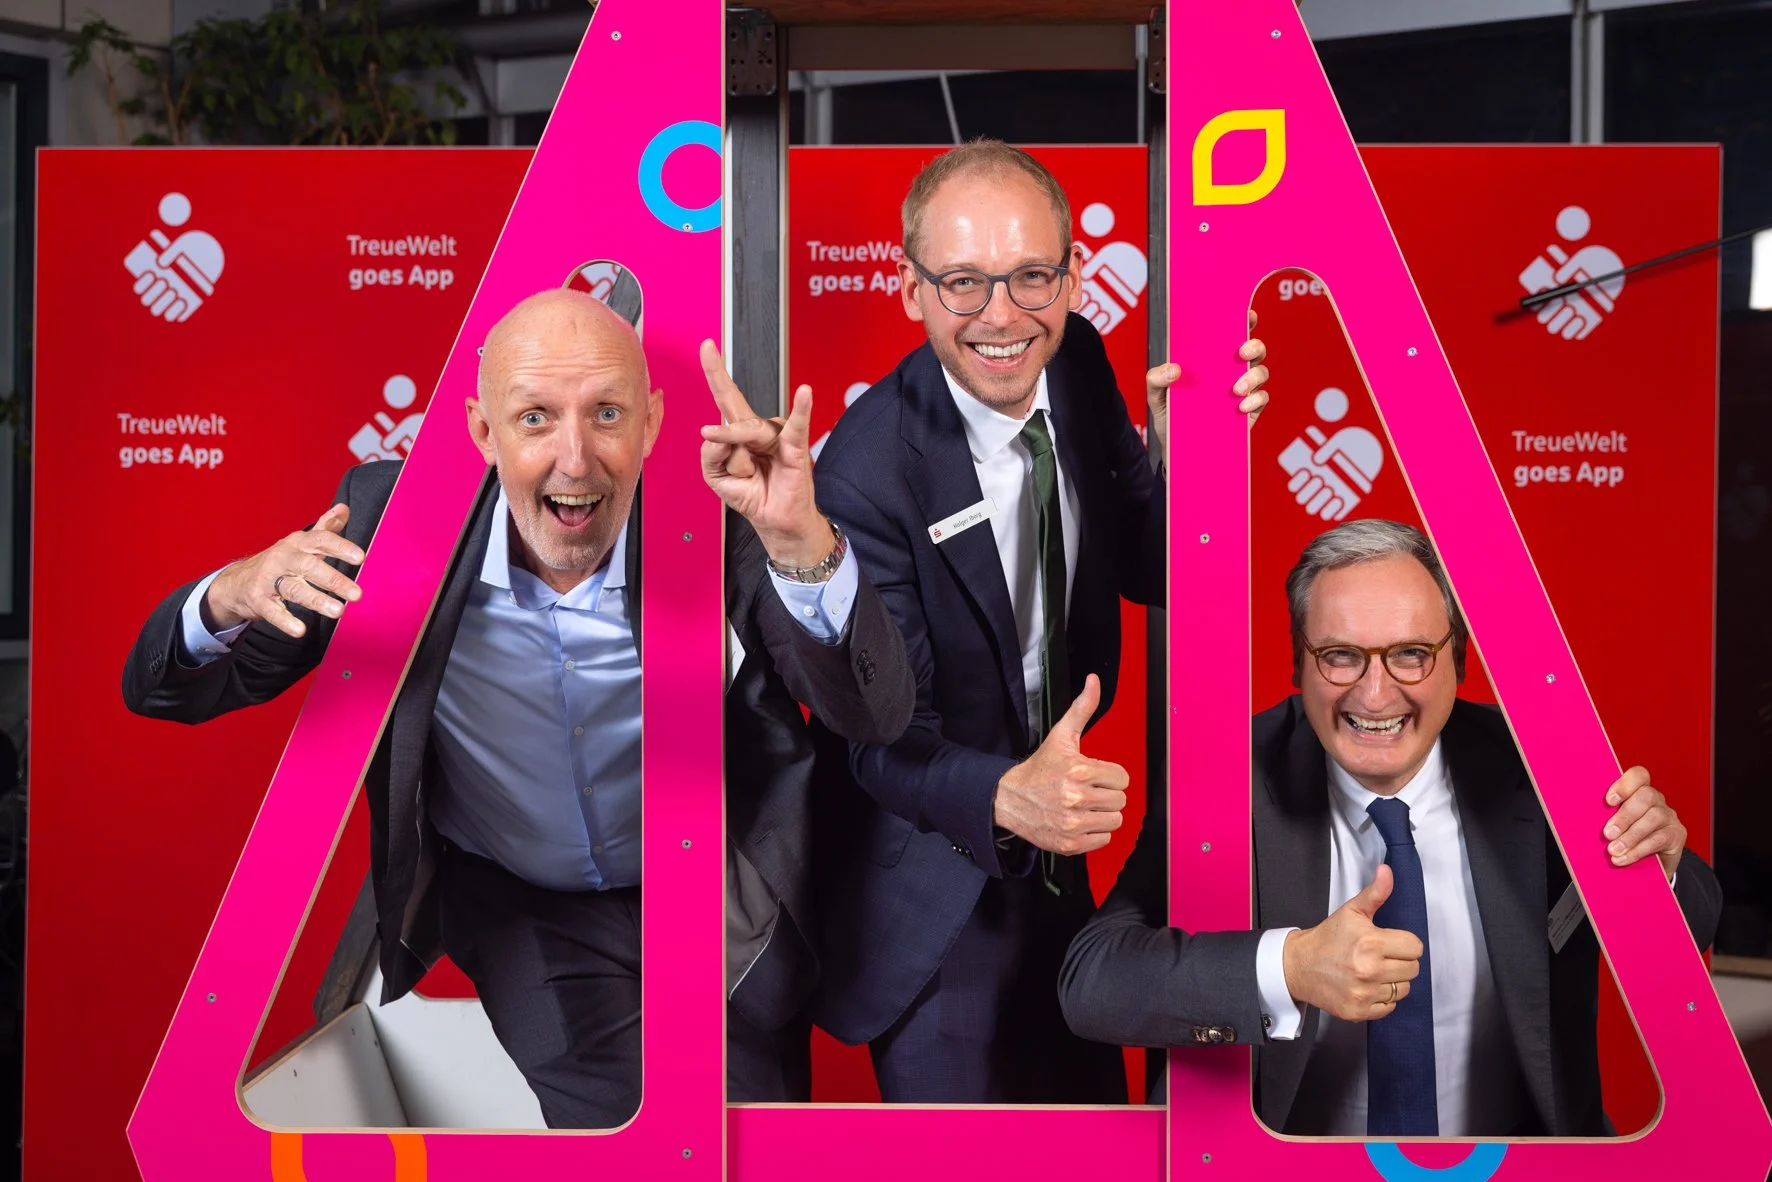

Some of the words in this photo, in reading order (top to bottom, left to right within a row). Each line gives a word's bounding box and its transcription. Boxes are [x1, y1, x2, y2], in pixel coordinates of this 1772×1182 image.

[346, 234, 457, 256] TreueWelt
[806, 240, 904, 262] TreueWe
[349, 268, 404, 290] goes
[408, 264, 454, 290] App
[808, 274, 865, 296] goes
[869, 270, 902, 296] Ap
[117, 412, 227, 435] TreueWelt
[1511, 430, 1627, 452] TreueWelt
[119, 446, 174, 468] goes
[178, 443, 224, 469] App
[1514, 465, 1571, 487] goes
[1575, 461, 1624, 487] App
